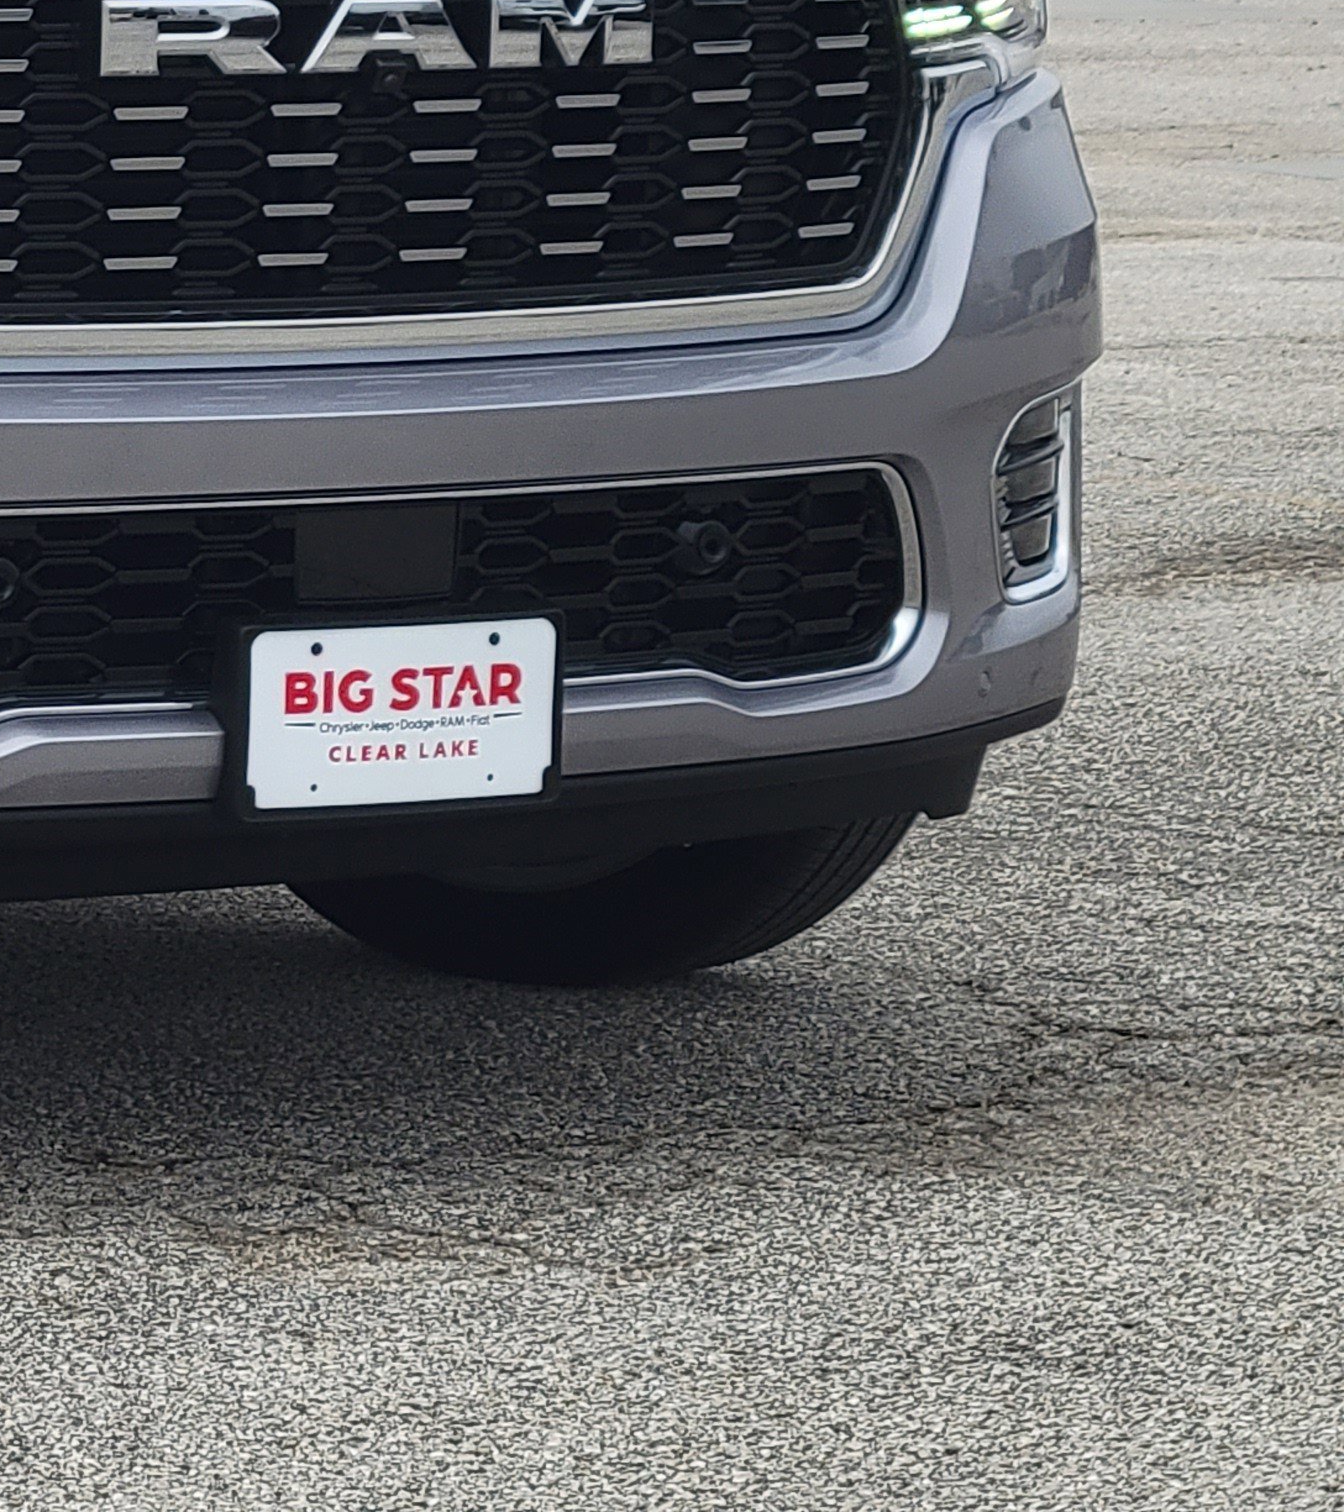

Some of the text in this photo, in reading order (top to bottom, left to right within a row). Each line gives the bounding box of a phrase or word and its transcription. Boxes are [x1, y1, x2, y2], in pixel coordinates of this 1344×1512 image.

[284, 663, 522, 715] BIG STAR
[327, 739, 480, 764] CLEAR LAKE
